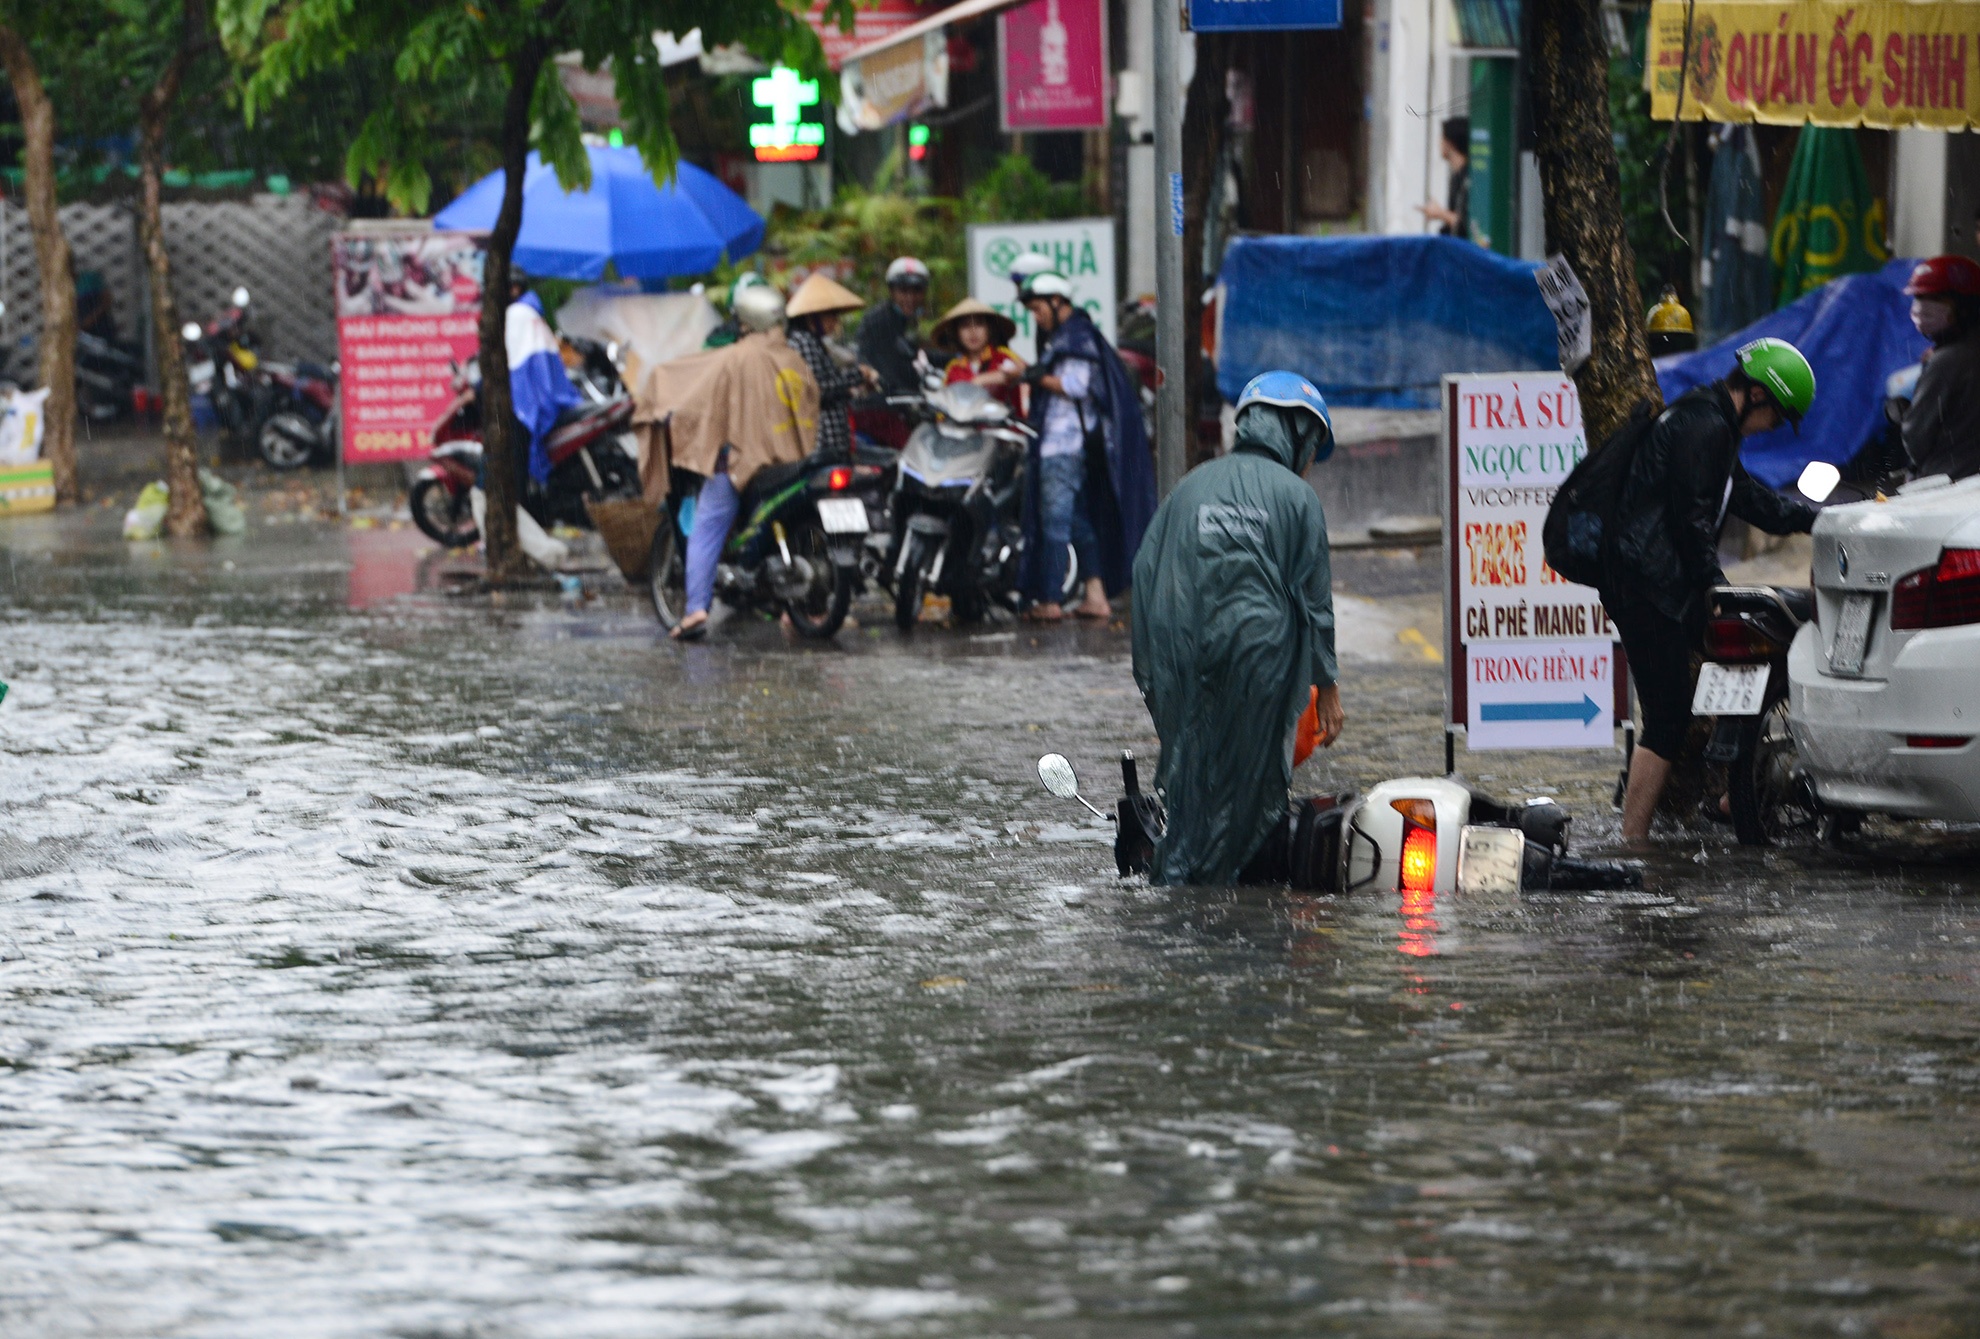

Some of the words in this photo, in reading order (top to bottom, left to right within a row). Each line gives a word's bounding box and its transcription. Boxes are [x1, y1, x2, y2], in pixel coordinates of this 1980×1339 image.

[1726, 12, 1818, 106] QUÁN
[1826, 9, 1873, 108] ỐC
[1882, 31, 1966, 110] SINH
[1463, 381, 1529, 430] TRÀ
[1538, 382, 1584, 430] SỮ
[1465, 443, 1532, 482] NGỌC
[1538, 434, 1587, 474] UYÊ
[1467, 599, 1491, 638] CÀ
[1495, 598, 1528, 638] PHÊ
[1534, 604, 1586, 637] MANG
[1472, 656, 1538, 684] TRONG
[1590, 655, 1608, 681] 47
